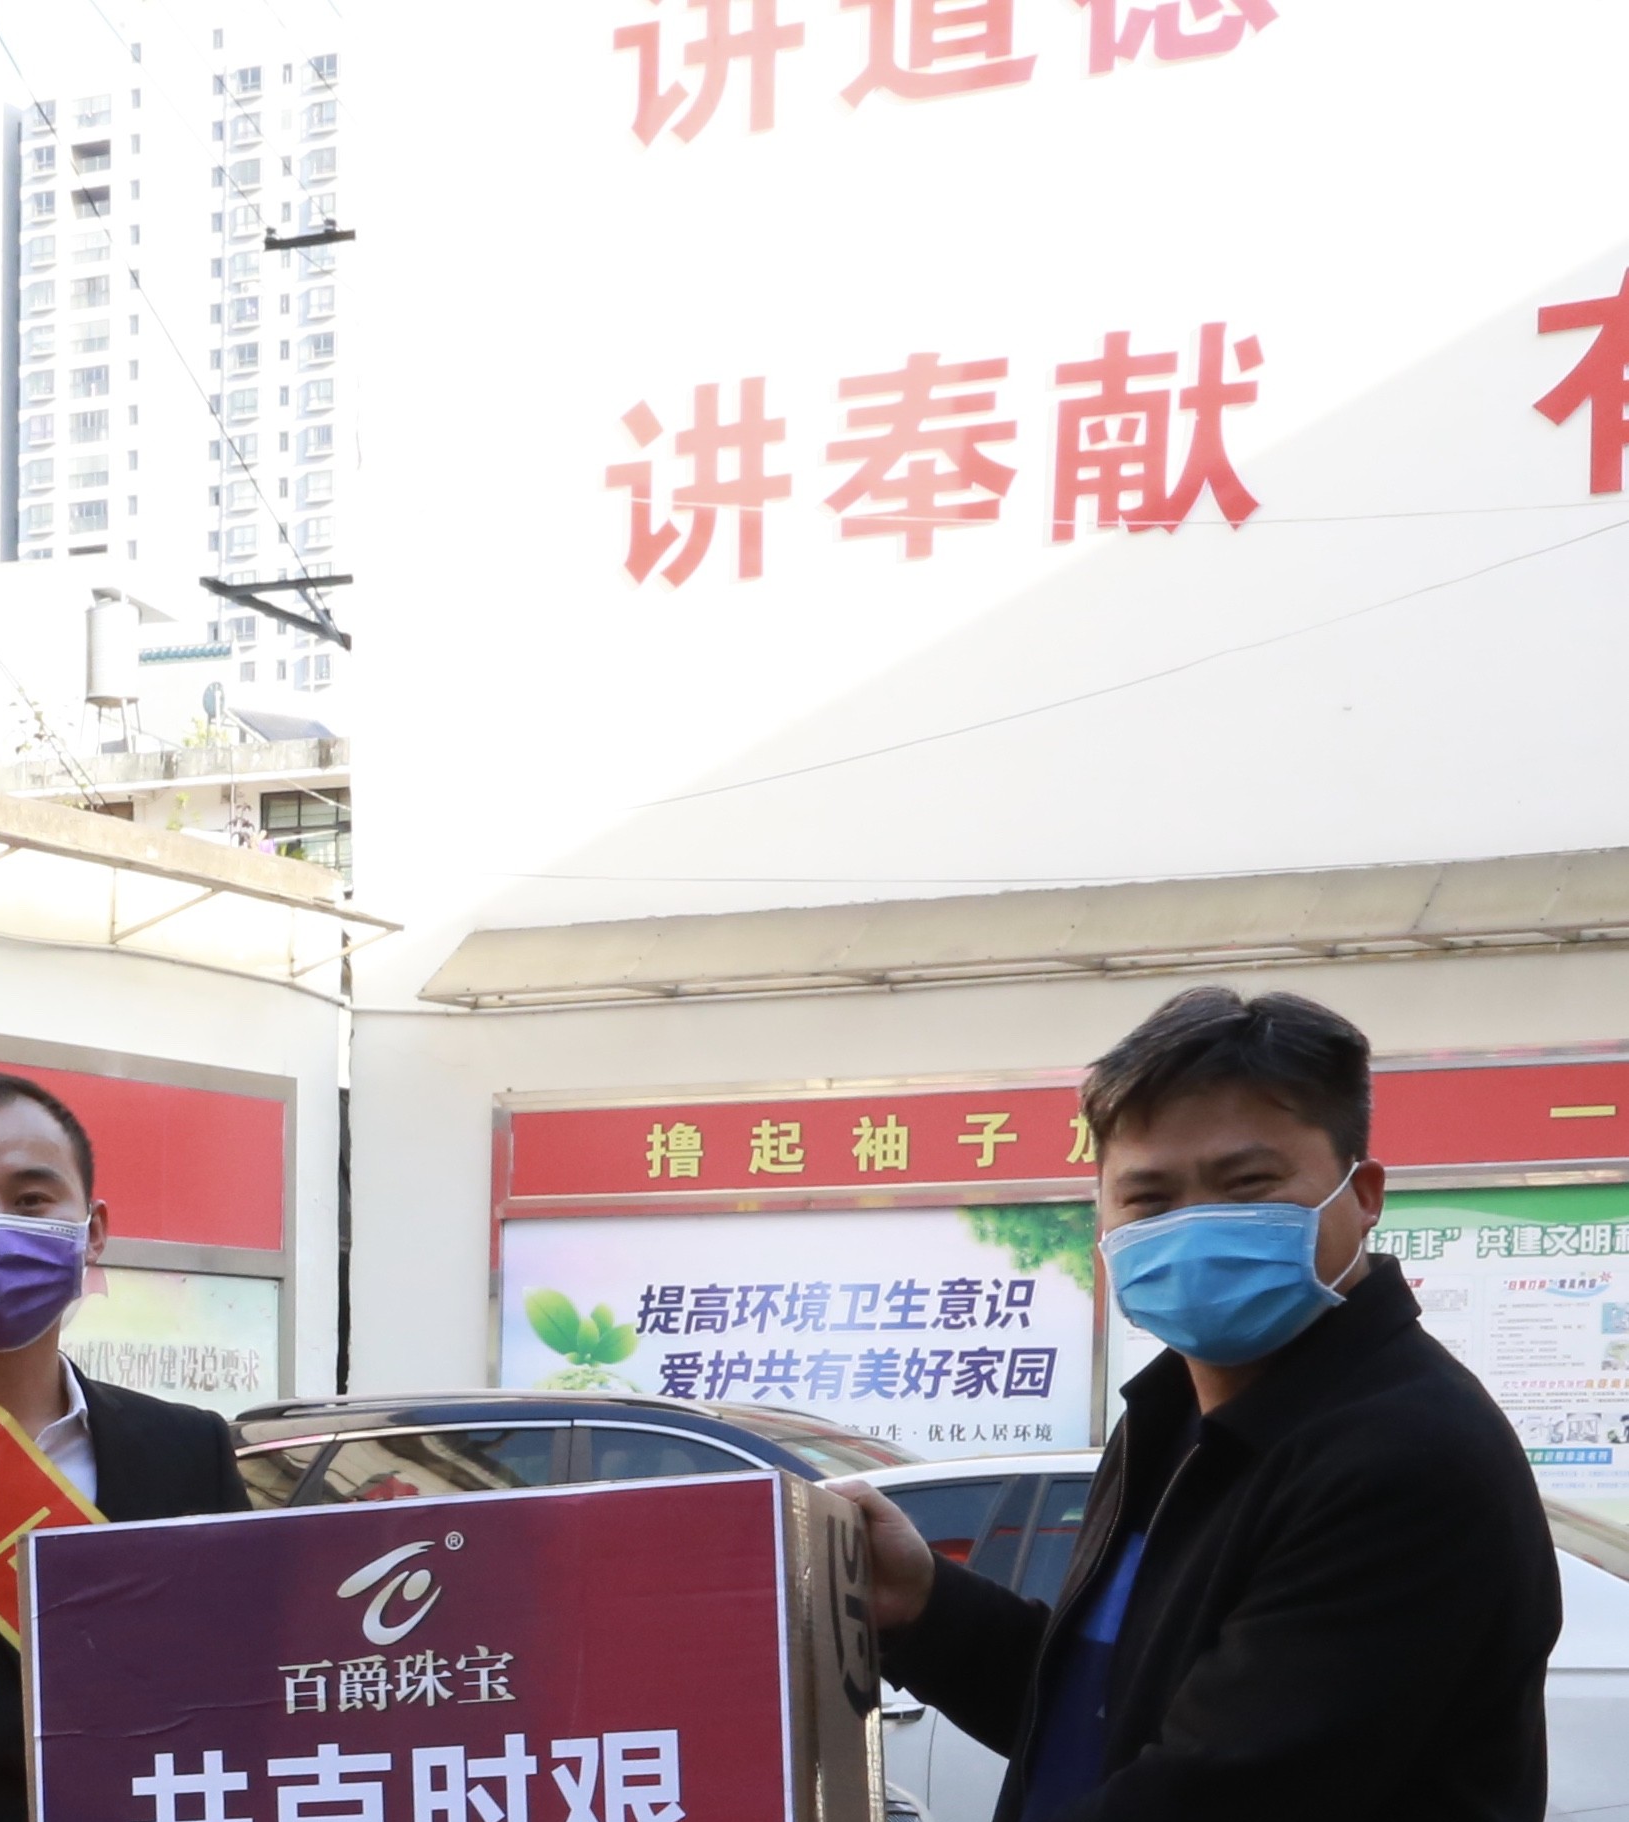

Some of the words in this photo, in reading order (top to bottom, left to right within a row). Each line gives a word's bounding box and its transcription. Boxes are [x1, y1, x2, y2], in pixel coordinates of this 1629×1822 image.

[605, 321, 1267, 590] 讲奉献
[635, 1278, 1037, 1336] 提高环境卫生意识
[63, 1338, 260, 1392] 时代党的建设总要求
[657, 1346, 1058, 1401] 爱护共有美好家园
[277, 1645, 516, 1715] 百爵珠宝
